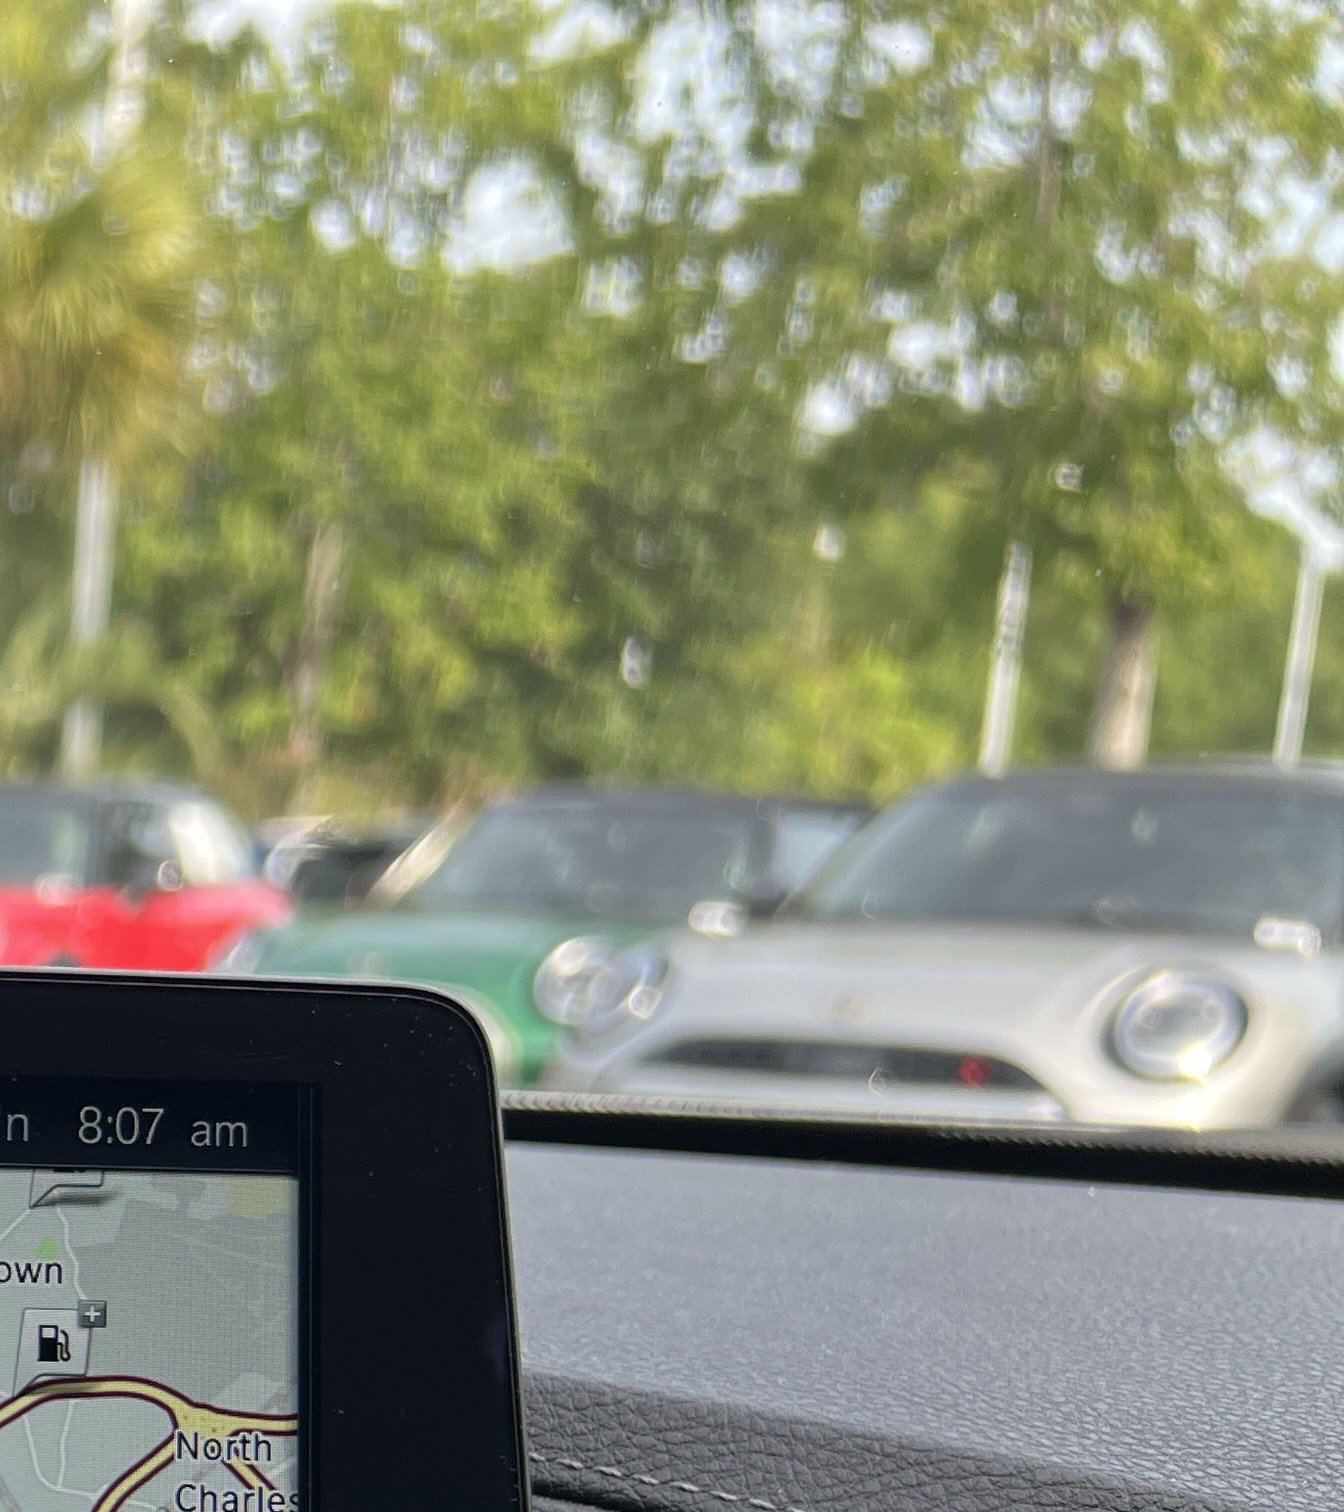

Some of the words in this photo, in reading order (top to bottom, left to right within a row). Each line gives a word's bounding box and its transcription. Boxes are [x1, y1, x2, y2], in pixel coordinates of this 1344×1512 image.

[77, 1107, 164, 1146] 8:07
[190, 1117, 248, 1147] am
[176, 1431, 272, 1462] North
